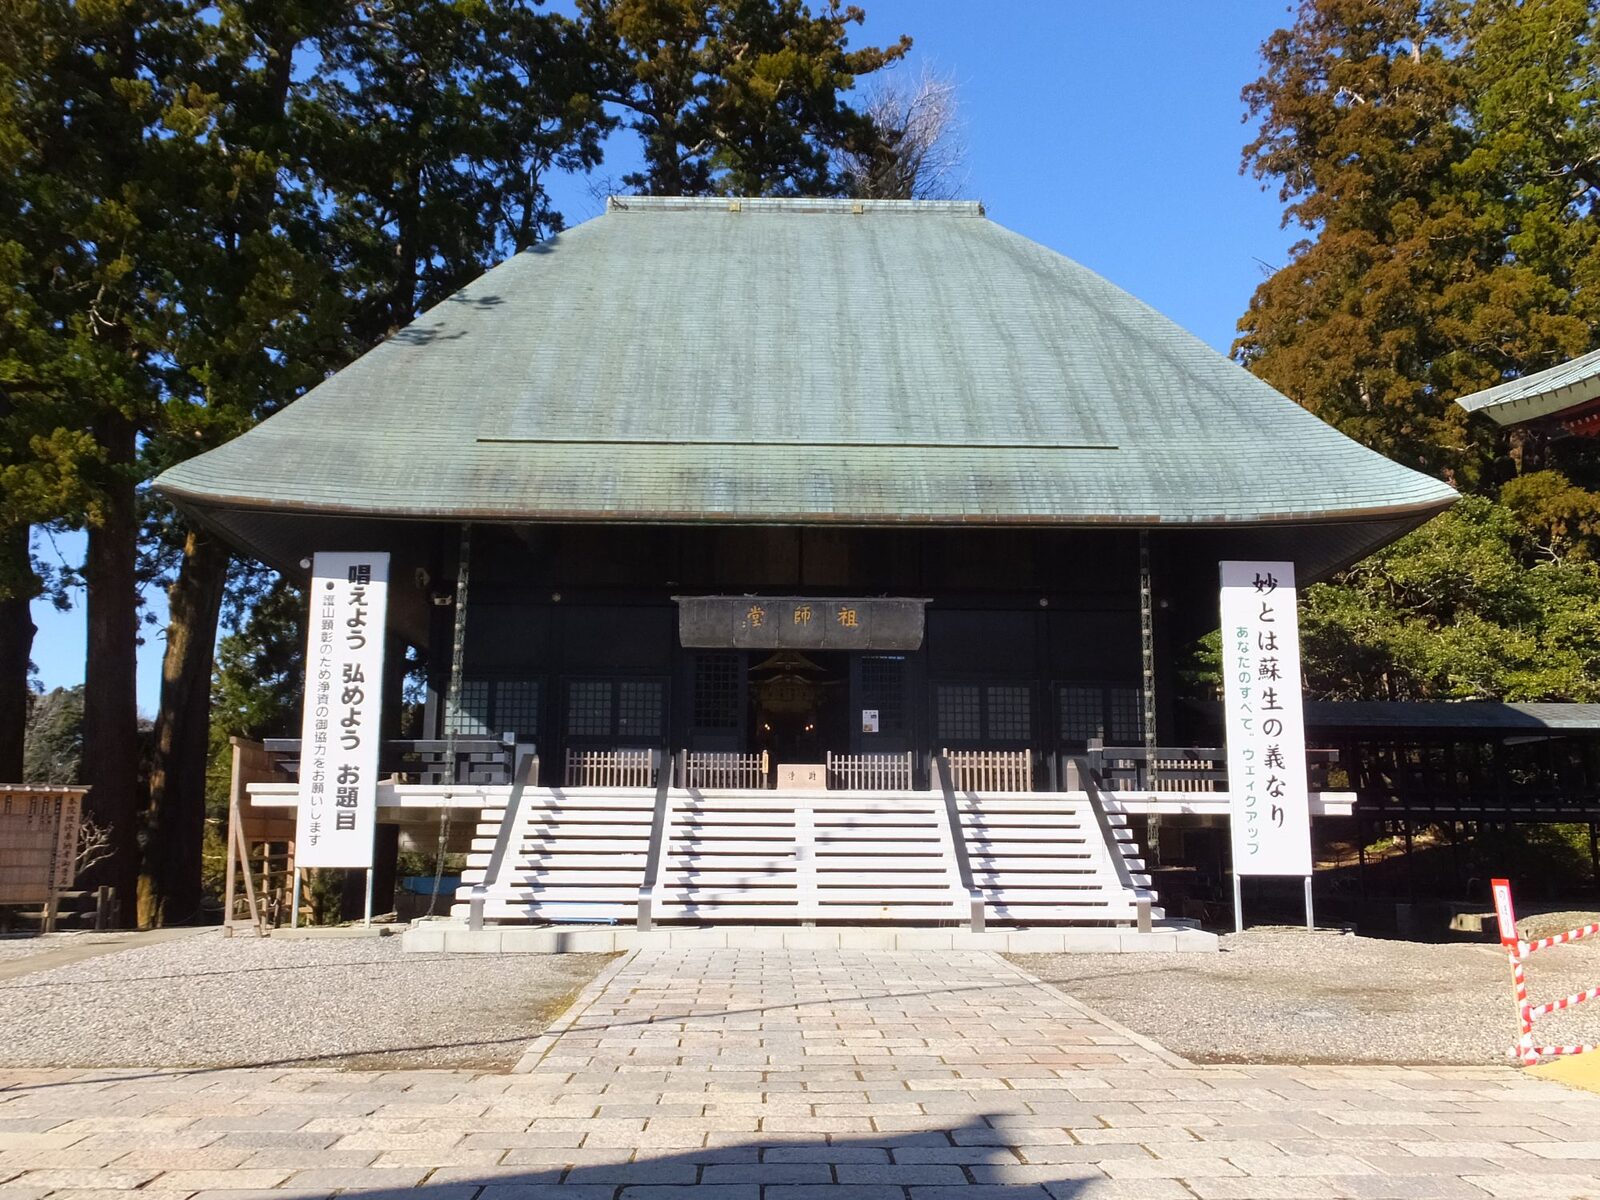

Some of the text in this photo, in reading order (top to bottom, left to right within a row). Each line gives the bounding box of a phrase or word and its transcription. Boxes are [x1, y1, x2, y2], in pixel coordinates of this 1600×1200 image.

[335, 564, 371, 831] 唱えよう 弘めよう お題目
[746, 604, 860, 629] 祖師堂
[1251, 572, 1286, 829] 妙とは蘇生の義なり
